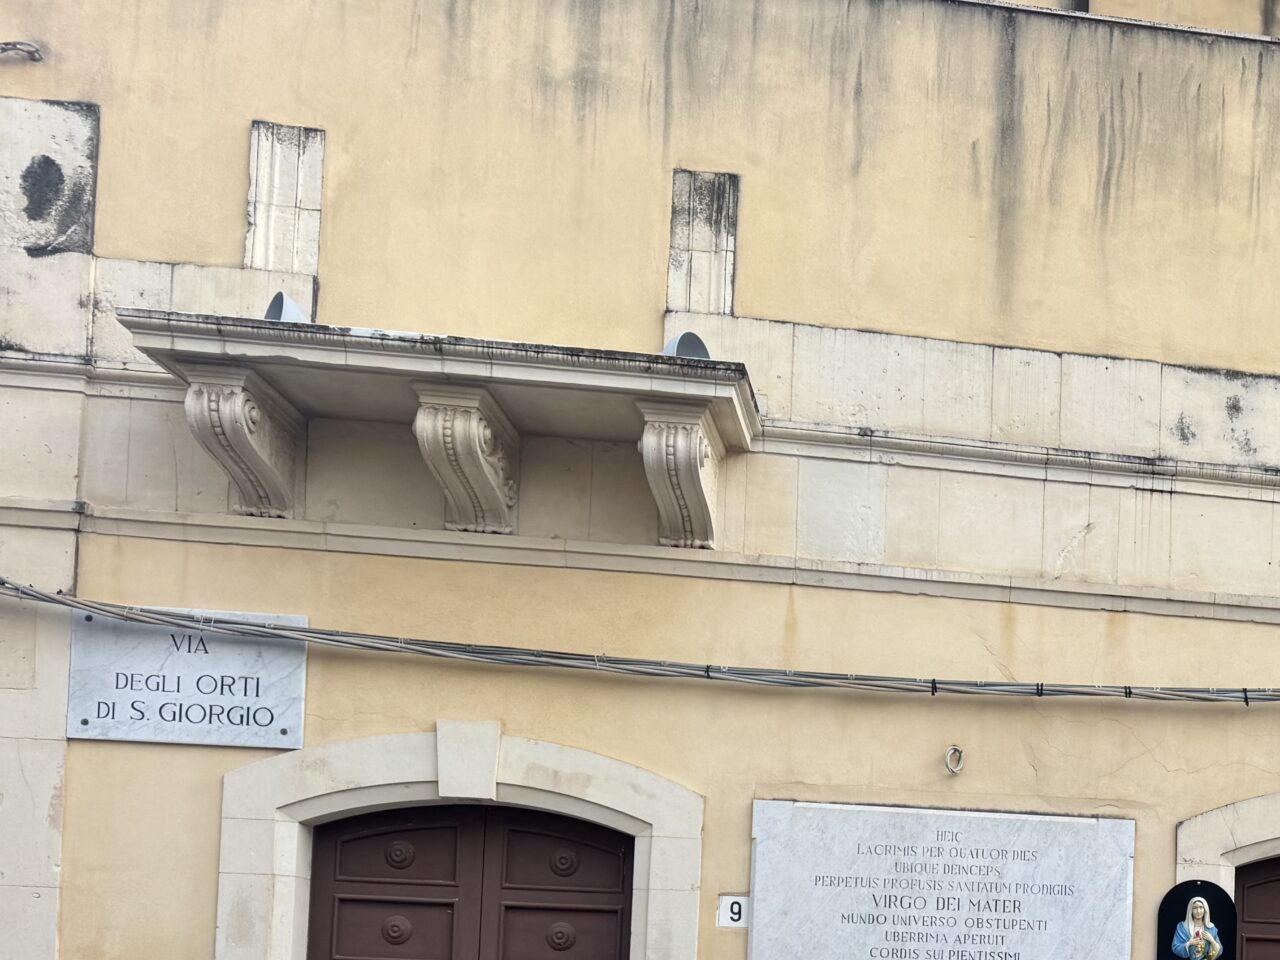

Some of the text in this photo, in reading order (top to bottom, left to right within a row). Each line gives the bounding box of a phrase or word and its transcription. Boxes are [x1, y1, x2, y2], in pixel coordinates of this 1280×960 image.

[170, 634, 209, 654] VIA
[115, 672, 260, 698] DEGLI ORTI
[96, 700, 274, 727] DI S. GIORGIO
[936, 830, 963, 843] HEIC
[857, 843, 918, 856] LACRIMIS
[922, 845, 945, 858] PER
[1012, 849, 1038, 861] DIES
[894, 861, 1001, 876] UBIQUE DEINCEPS
[814, 875, 1075, 896] PERPETUIS PROFUSIS SANITATUM PRODIGIIS
[730, 900, 742, 922] 9
[872, 894, 1022, 913] VIRGO DEI MATER
[841, 912, 1047, 931] MUNDO UNIVERSO OBSTUPENTI
[885, 930, 1007, 946] UBERRIMA APERUIT
[869, 947, 920, 960] CORDIS
[925, 949, 944, 960] SUI
